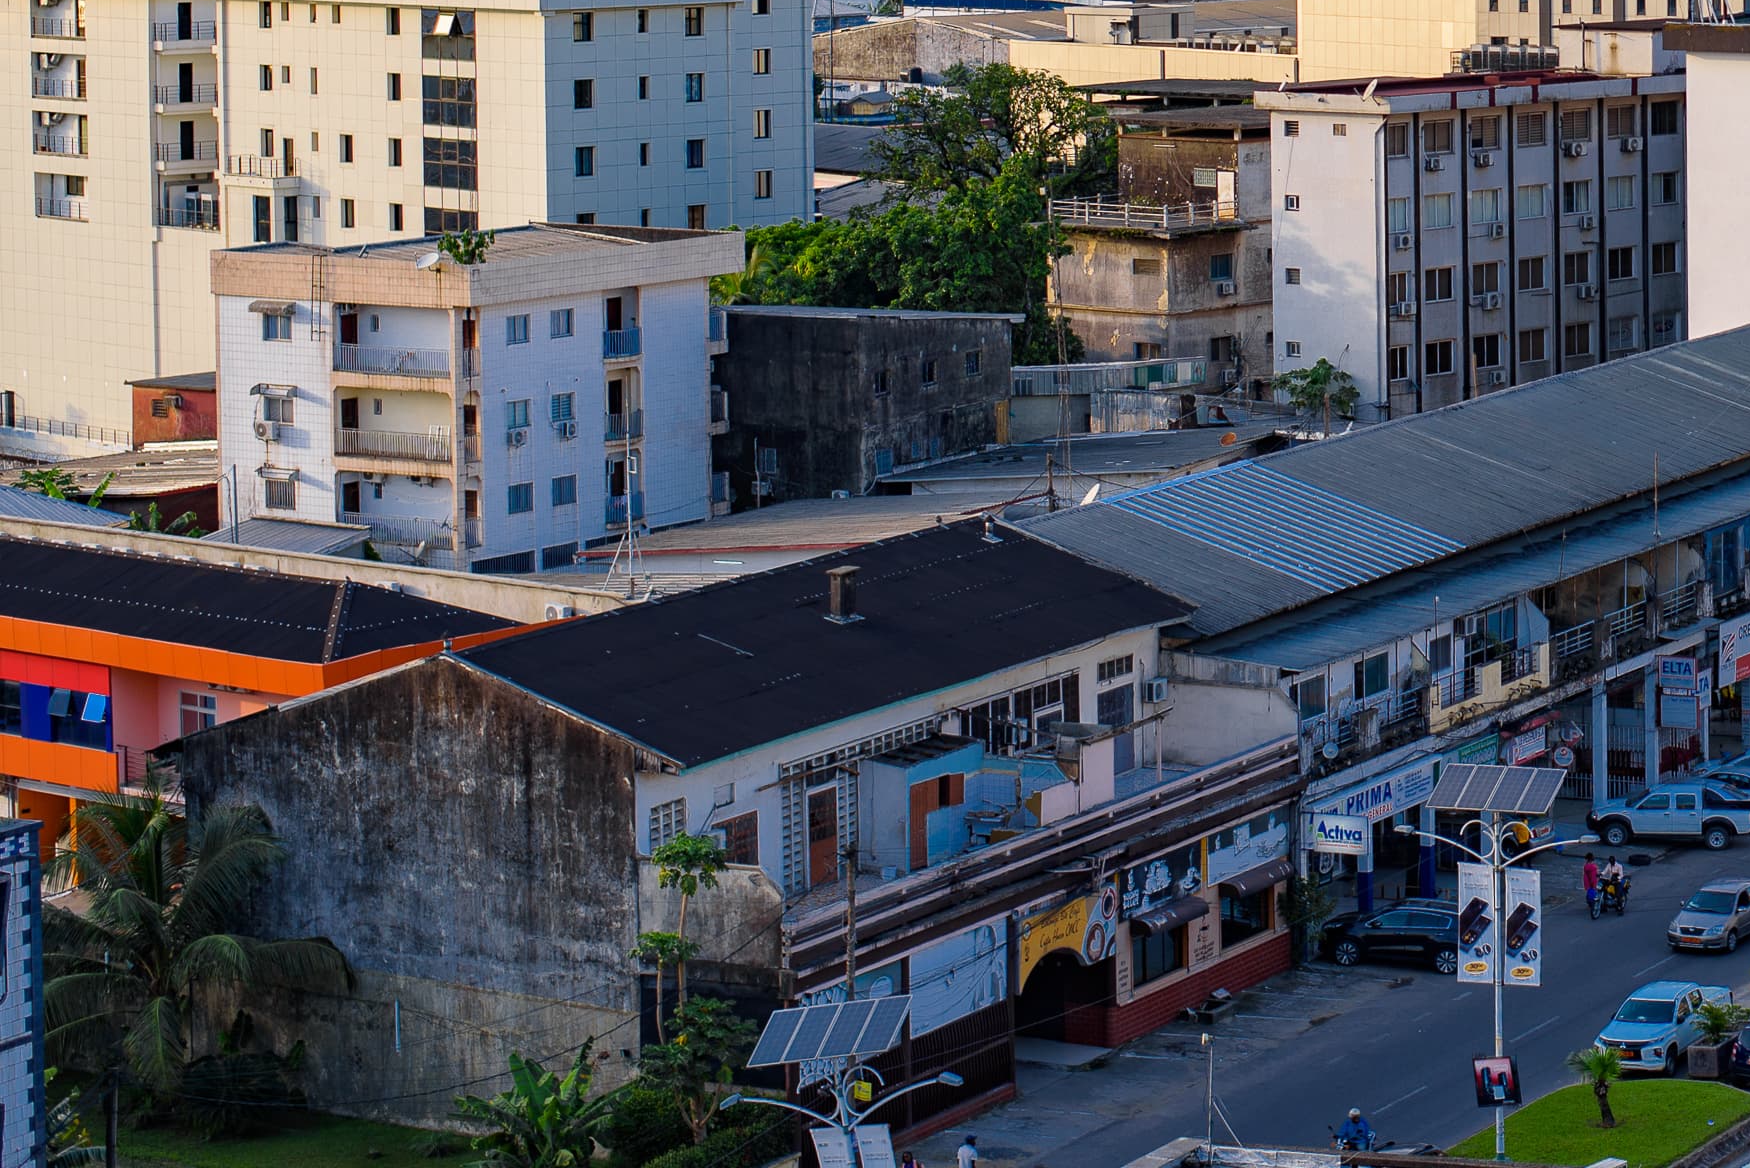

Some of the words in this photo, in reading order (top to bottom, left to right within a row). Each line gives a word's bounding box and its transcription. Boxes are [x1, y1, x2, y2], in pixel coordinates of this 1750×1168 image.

[1663, 661, 1692, 675] ELTA
[1346, 781, 1392, 816] PRIMA
[1318, 820, 1362, 841] Activa
